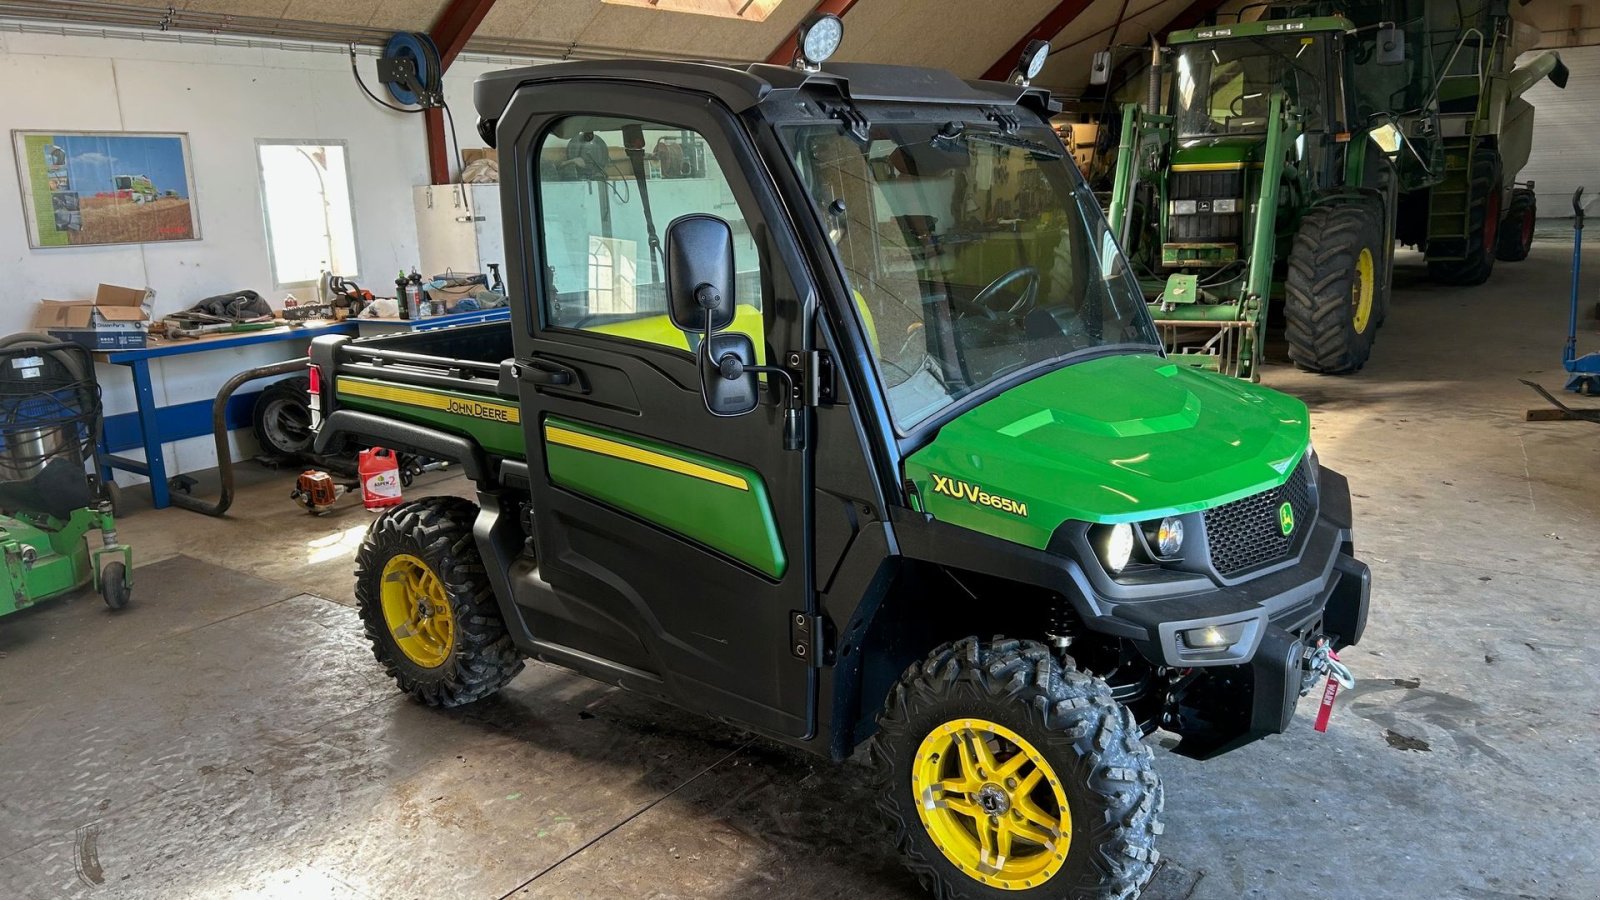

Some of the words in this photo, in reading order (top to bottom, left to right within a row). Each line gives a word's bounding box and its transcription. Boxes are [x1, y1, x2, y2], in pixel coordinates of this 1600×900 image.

[447, 399, 473, 415] JOHN
[474, 403, 508, 421] DEERE
[389, 475, 396, 486] 2
[1323, 684, 1337, 706] WARN
